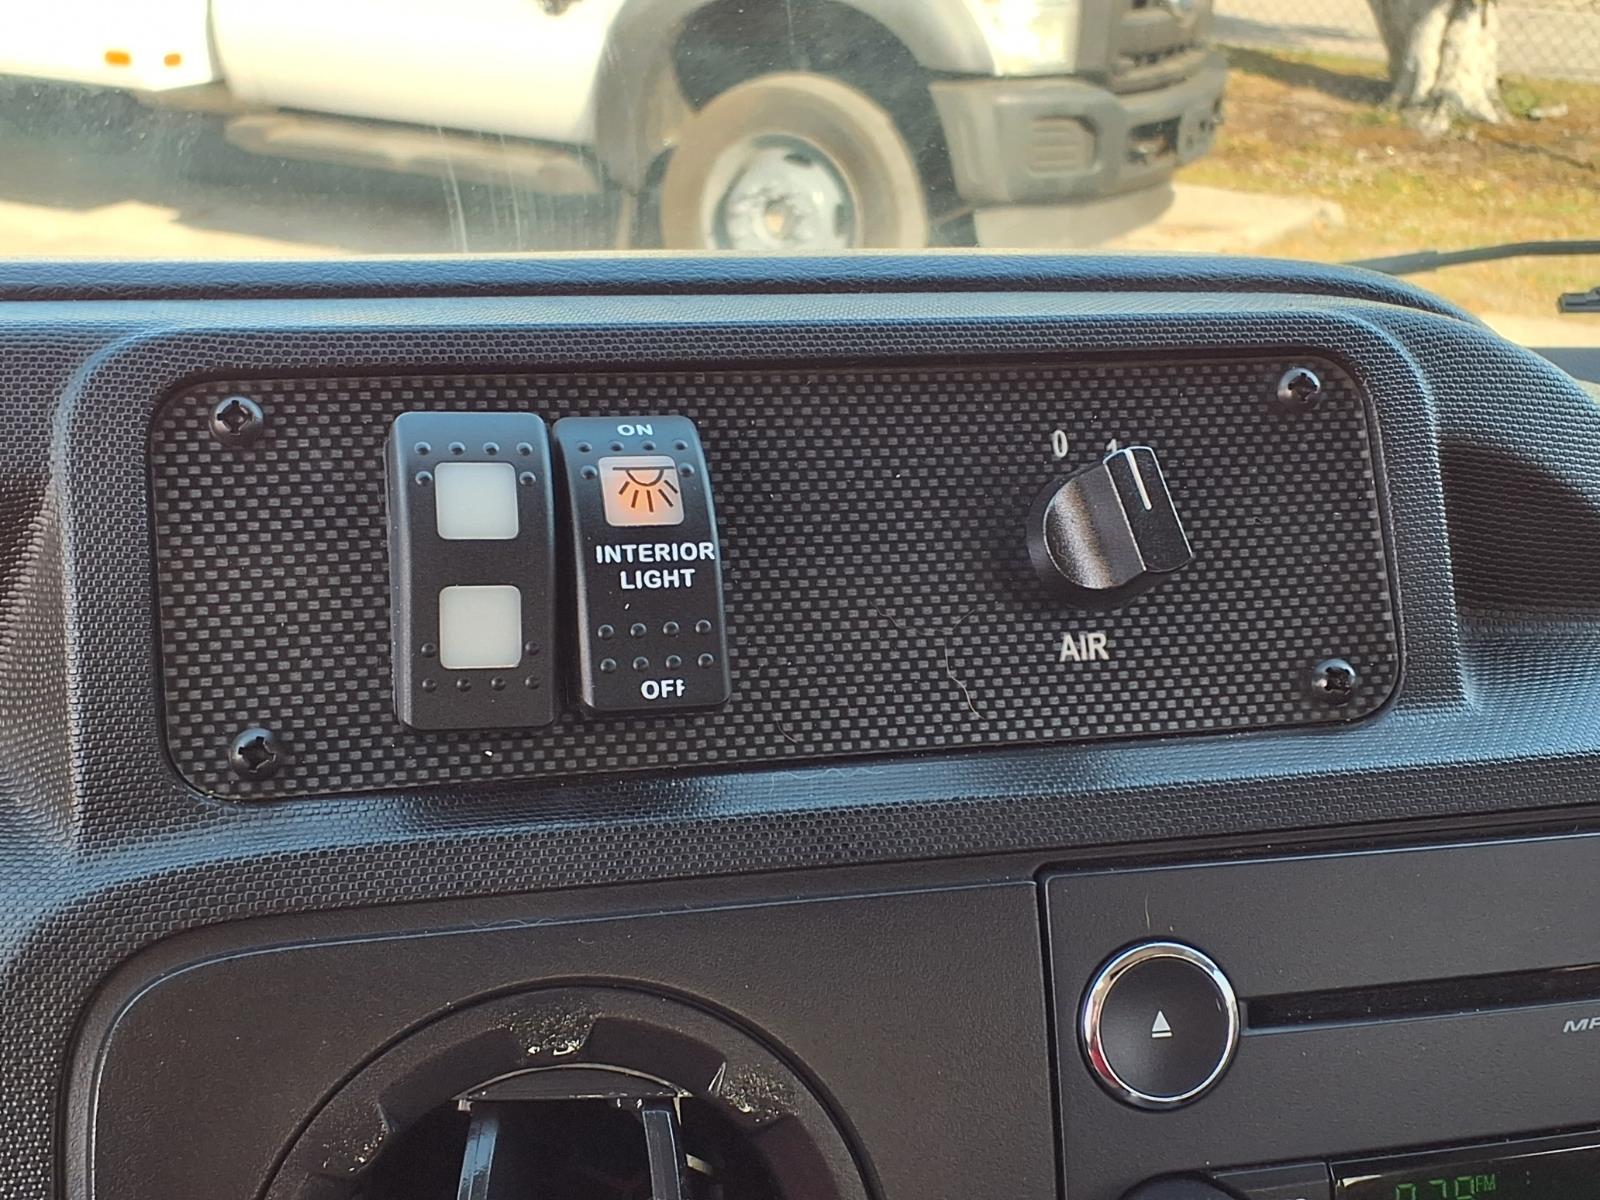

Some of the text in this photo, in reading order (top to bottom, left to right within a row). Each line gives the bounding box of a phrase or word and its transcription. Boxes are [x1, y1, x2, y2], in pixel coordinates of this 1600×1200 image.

[617, 423, 653, 436] ON
[1051, 429, 1069, 458] 0
[595, 541, 716, 564] INTERIOR
[619, 568, 696, 590] LIGHT
[1058, 632, 1111, 662] AIR
[1475, 1173, 1497, 1193] FM
